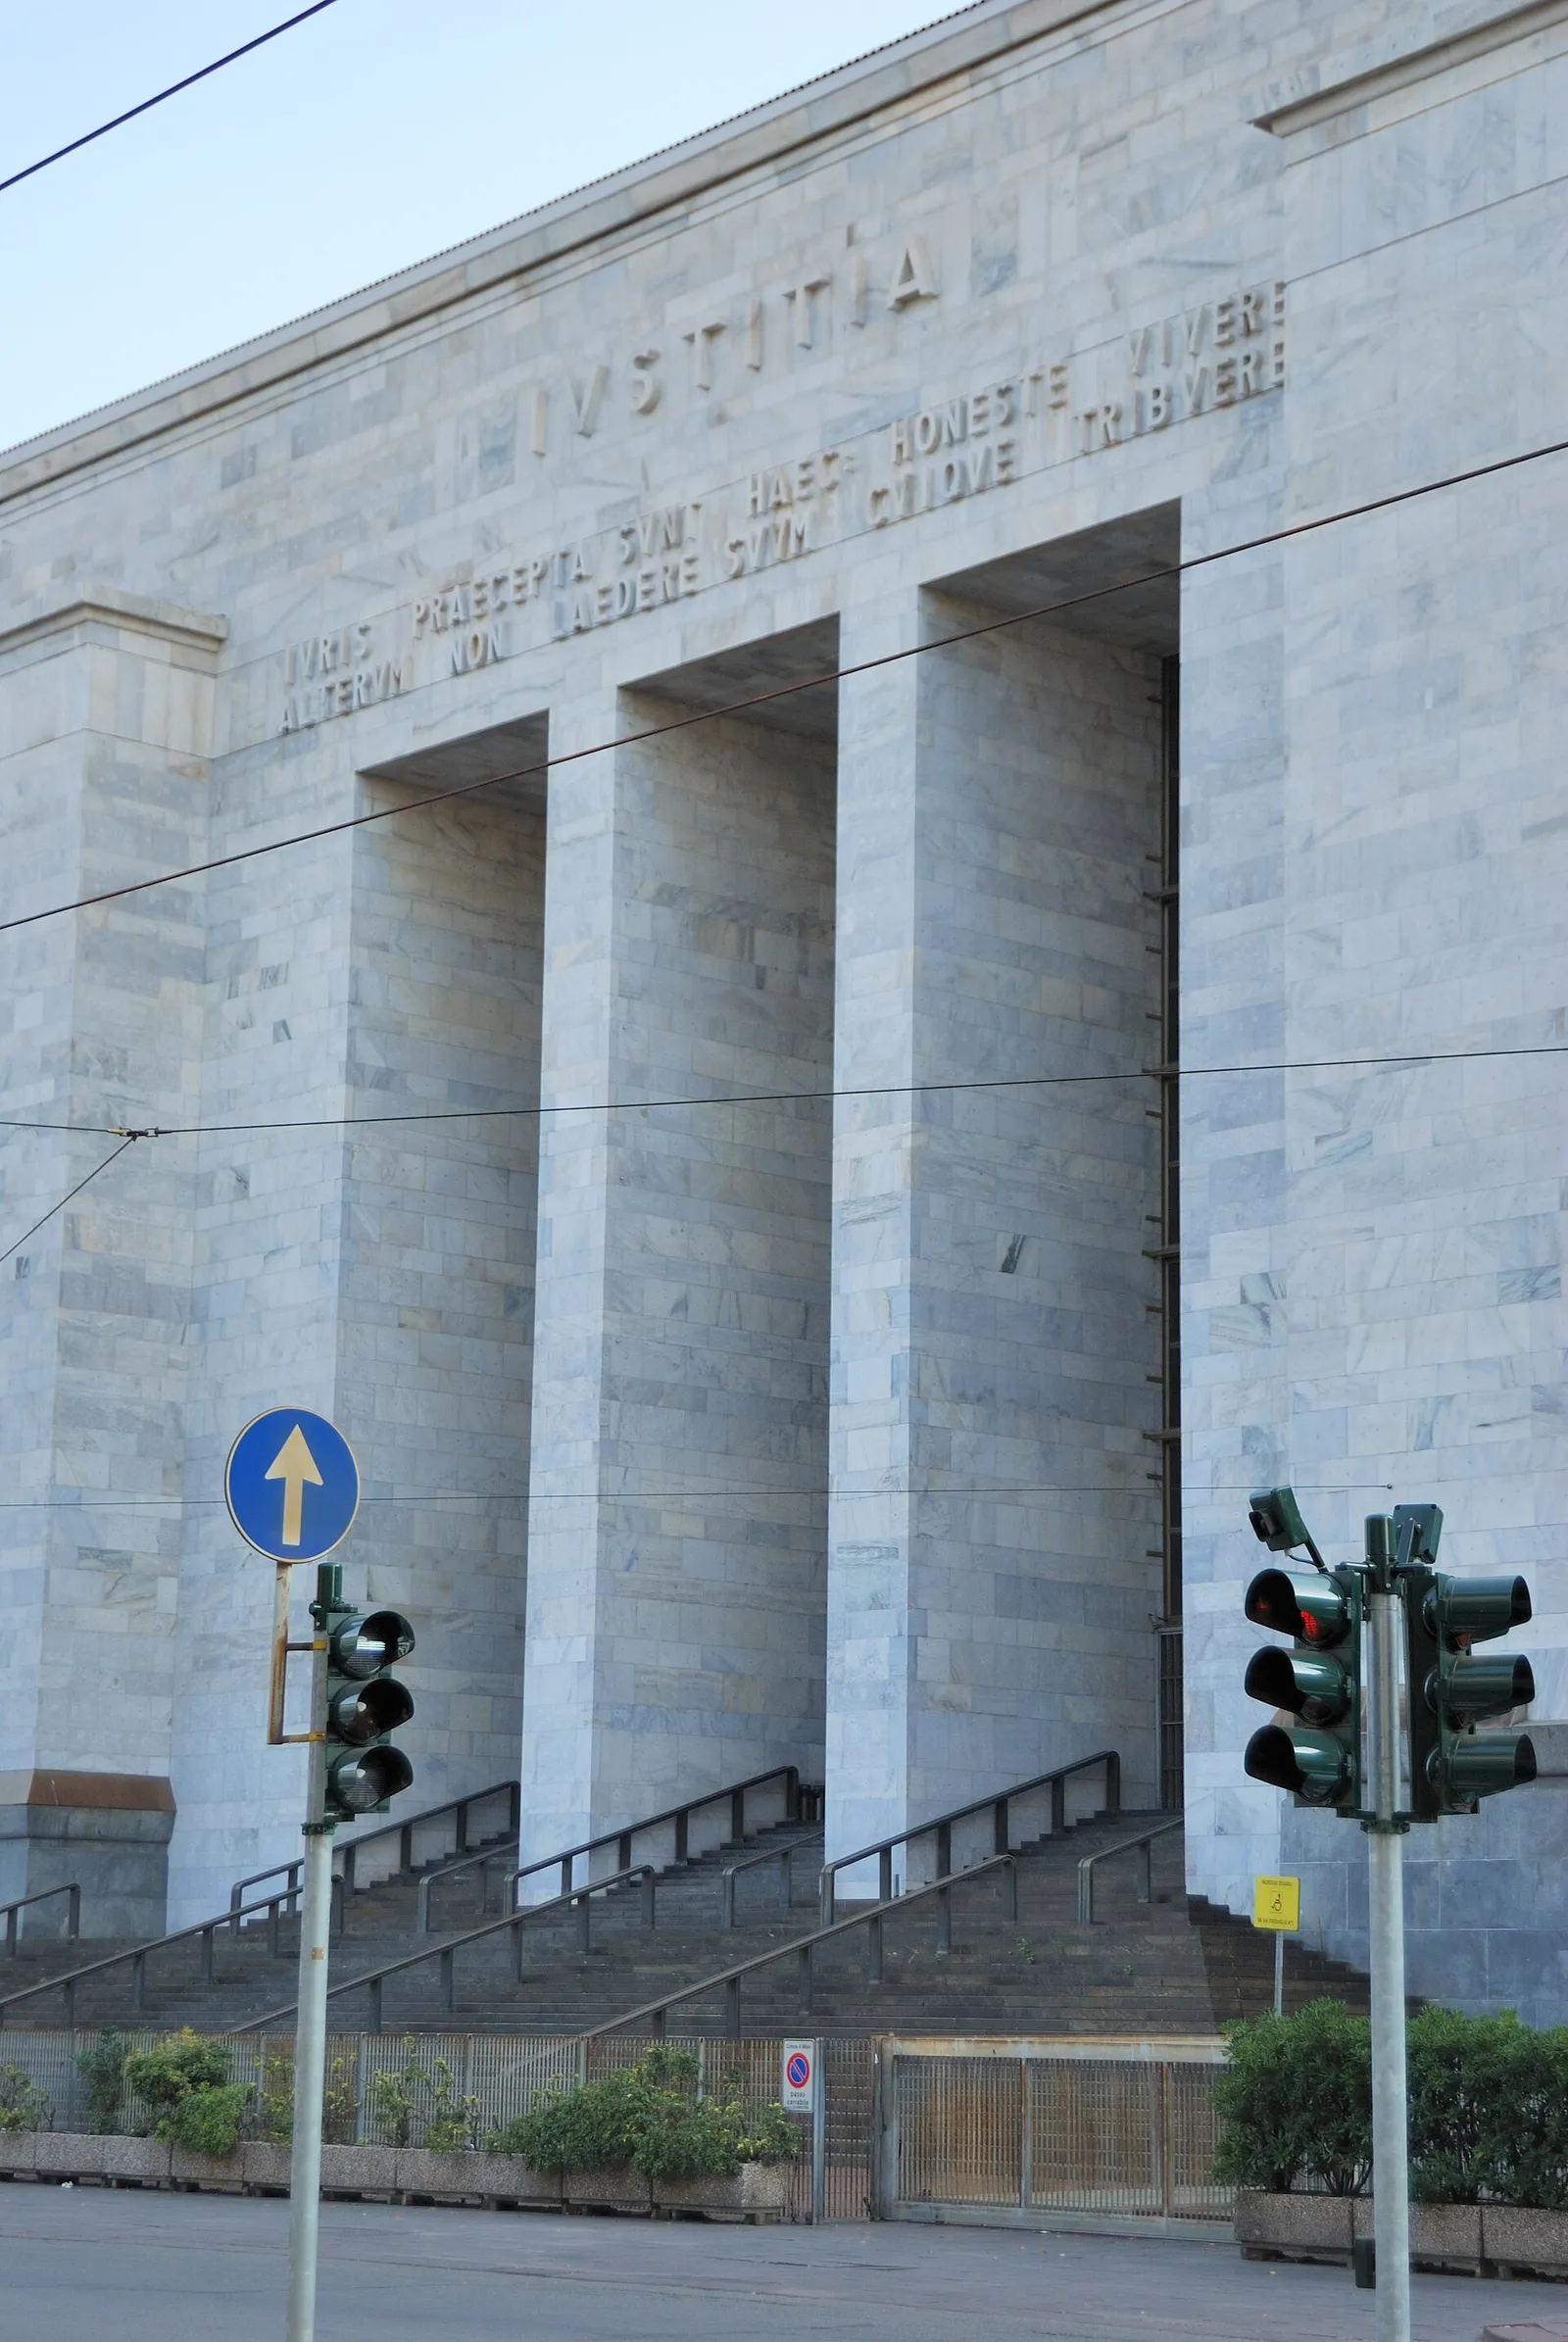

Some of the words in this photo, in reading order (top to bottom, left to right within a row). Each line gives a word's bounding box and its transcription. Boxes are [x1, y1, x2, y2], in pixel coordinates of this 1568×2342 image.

[279, 653, 416, 735] ALTERVM
[450, 619, 514, 676] NON
[554, 552, 699, 642] LAEDERE
[726, 509, 815, 579] SVVM
[867, 438, 1015, 529] CVIQVE
[1072, 341, 1285, 456] TRIBVERE
[285, 622, 371, 685] IVRIS
[413, 542, 592, 640] PRAECEPTA
[619, 501, 705, 565] SVNT
[891, 363, 1068, 466] HONESTE
[1127, 280, 1285, 377] VIVERE
[530, 231, 941, 459] IVSTITIA
